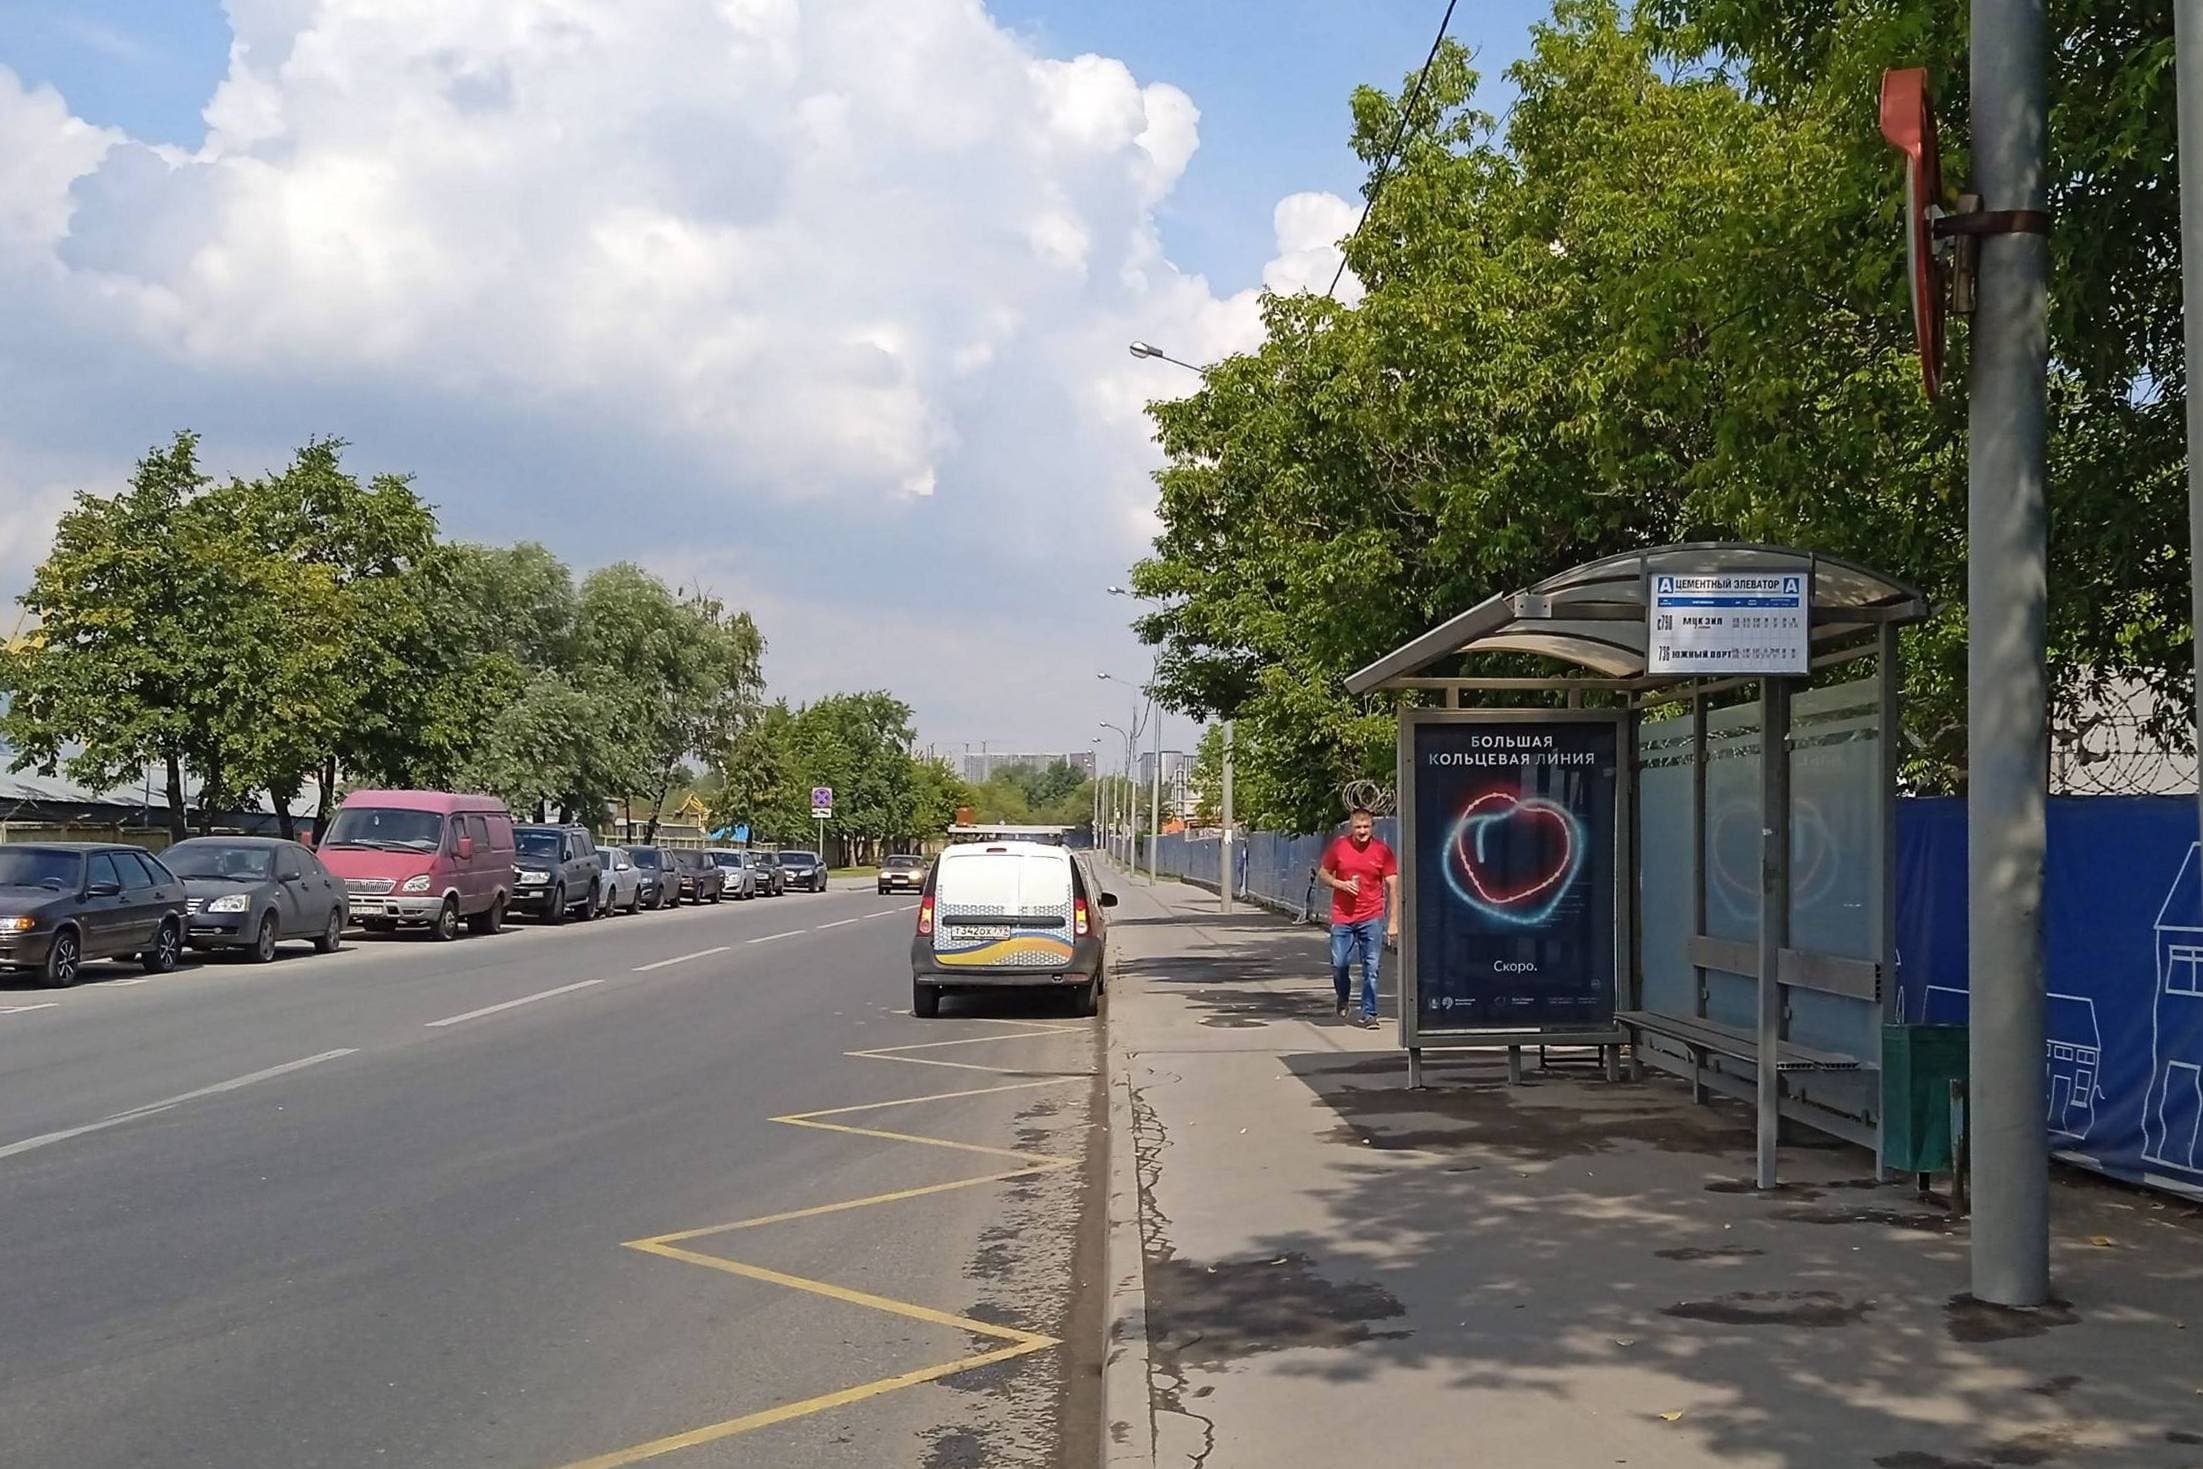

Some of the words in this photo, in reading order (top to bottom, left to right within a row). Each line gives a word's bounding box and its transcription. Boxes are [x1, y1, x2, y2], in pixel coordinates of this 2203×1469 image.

[1675, 578, 1732, 590] ЦЕМЕНТНЫЙ
[1734, 579, 1780, 590] ЭЛЕВАТОР
[1671, 650, 1709, 659] ЮЖНЫЙ
[1710, 650, 1731, 659] ПОРТ
[1471, 735, 1553, 749] БОЛЬШАЯ
[1429, 753, 1530, 767] КОЛЬЦЕВАЯ
[1535, 752, 1595, 766] ЛИНИЯ
[1493, 960, 1538, 974] Скоро.
